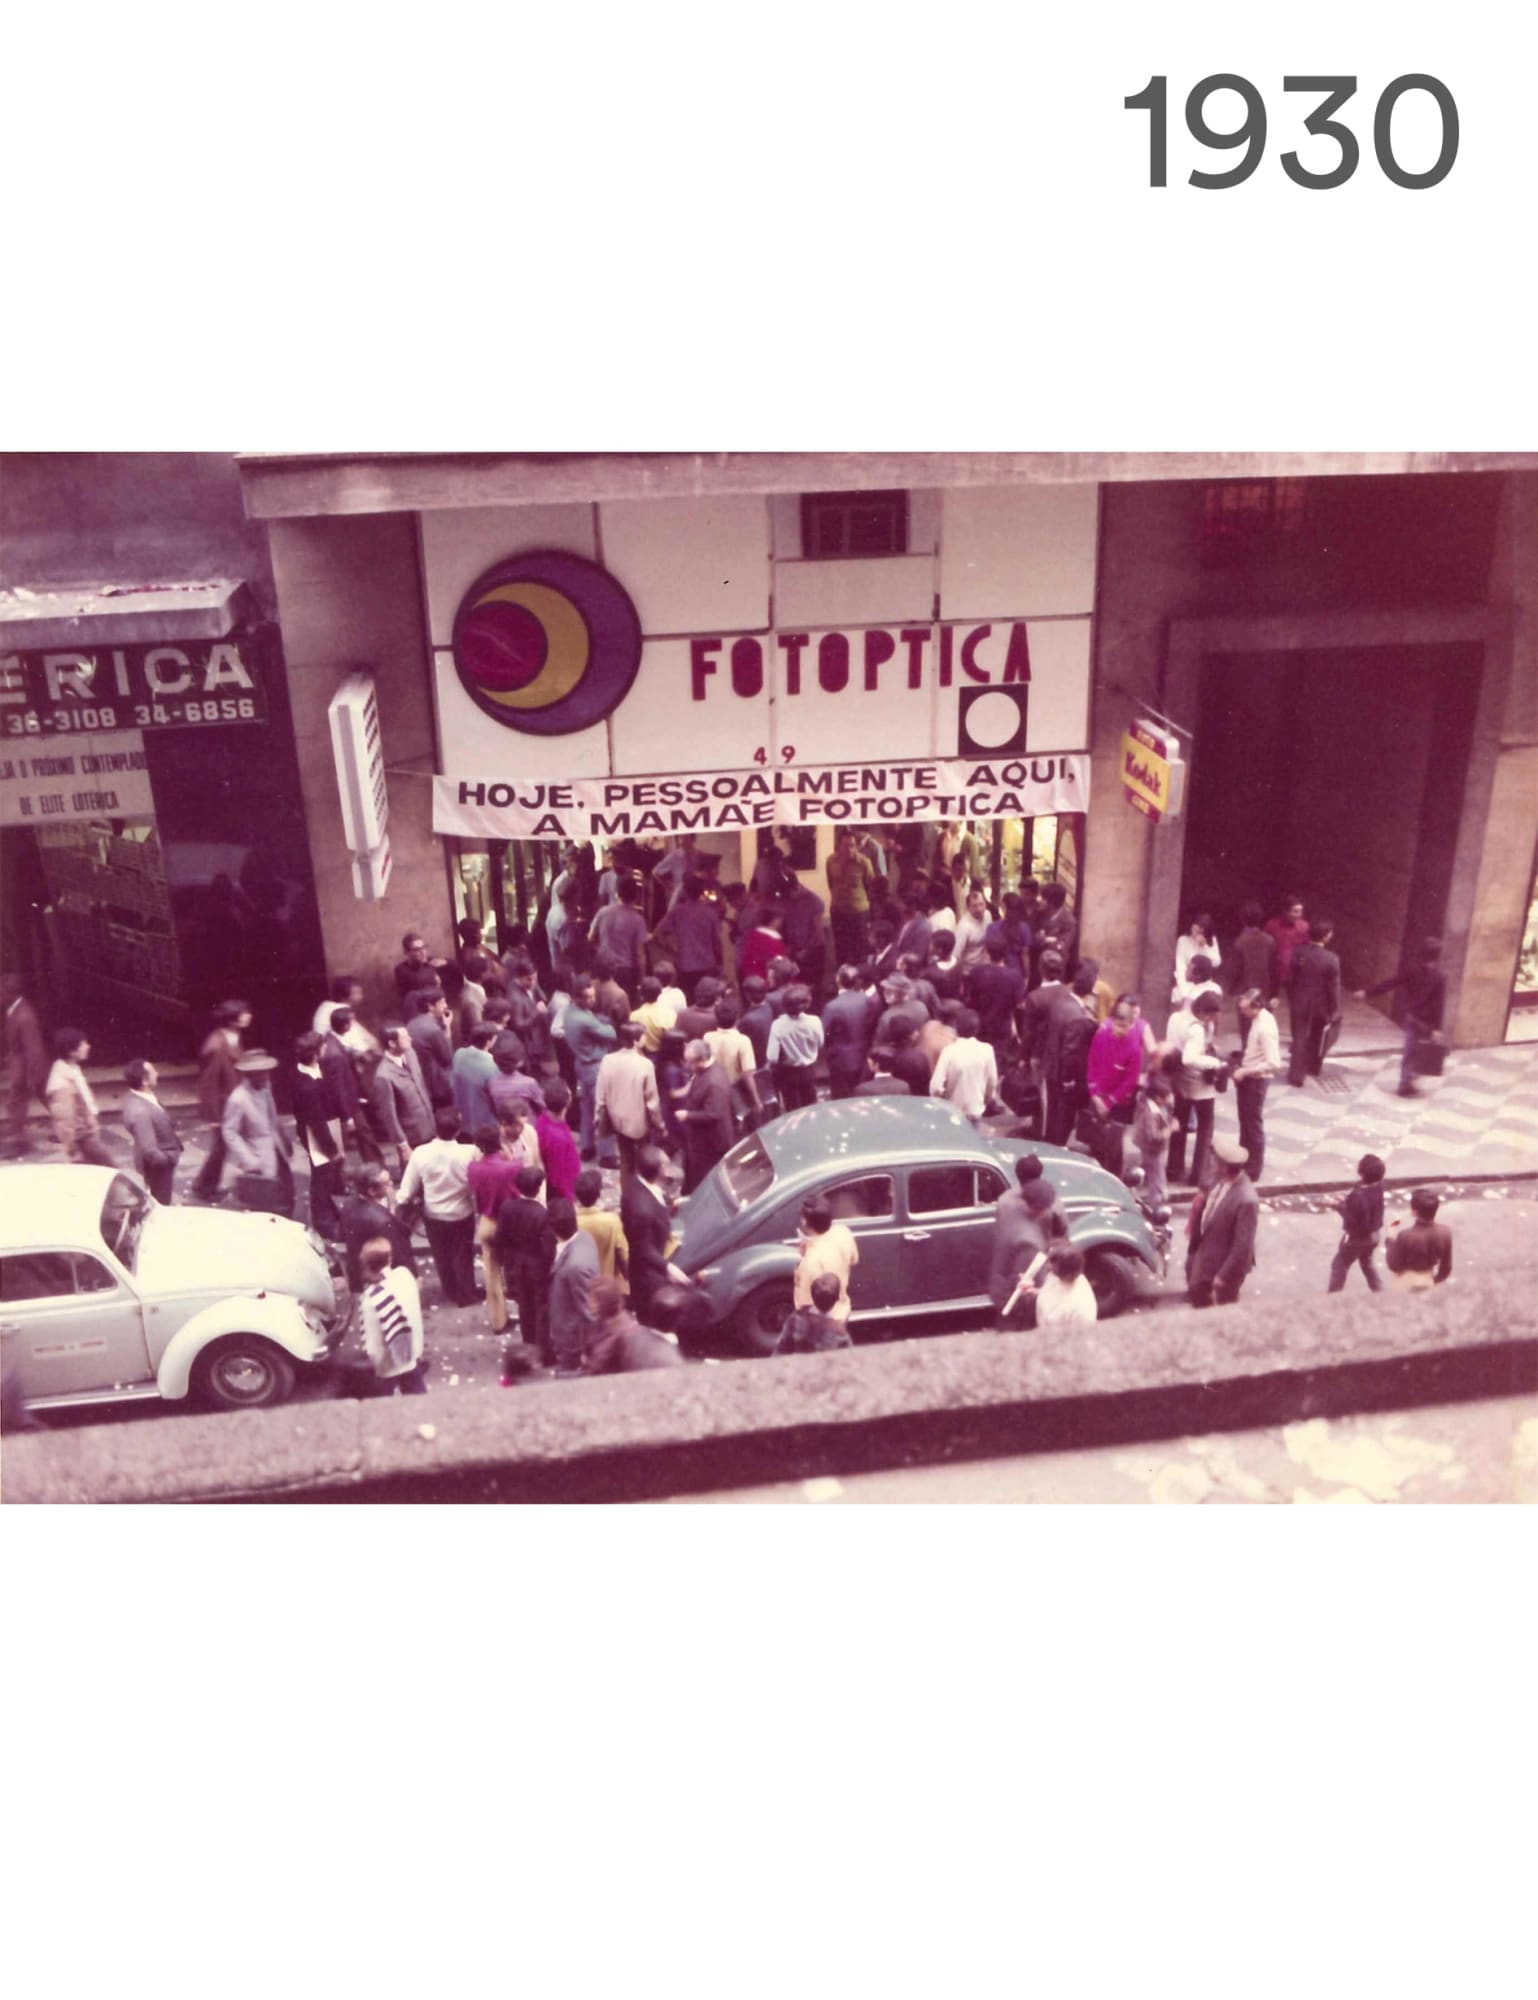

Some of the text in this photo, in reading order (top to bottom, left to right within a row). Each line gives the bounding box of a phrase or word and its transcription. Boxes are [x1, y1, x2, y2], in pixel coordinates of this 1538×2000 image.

[690, 622, 1032, 701] FOTOPTICA
[134, 698, 255, 725] 34-6856
[604, 767, 937, 808] PESSOALMENTE
[966, 757, 1076, 789] AQUI,
[531, 792, 1025, 836] A MAMÃE FOTOPTICA
